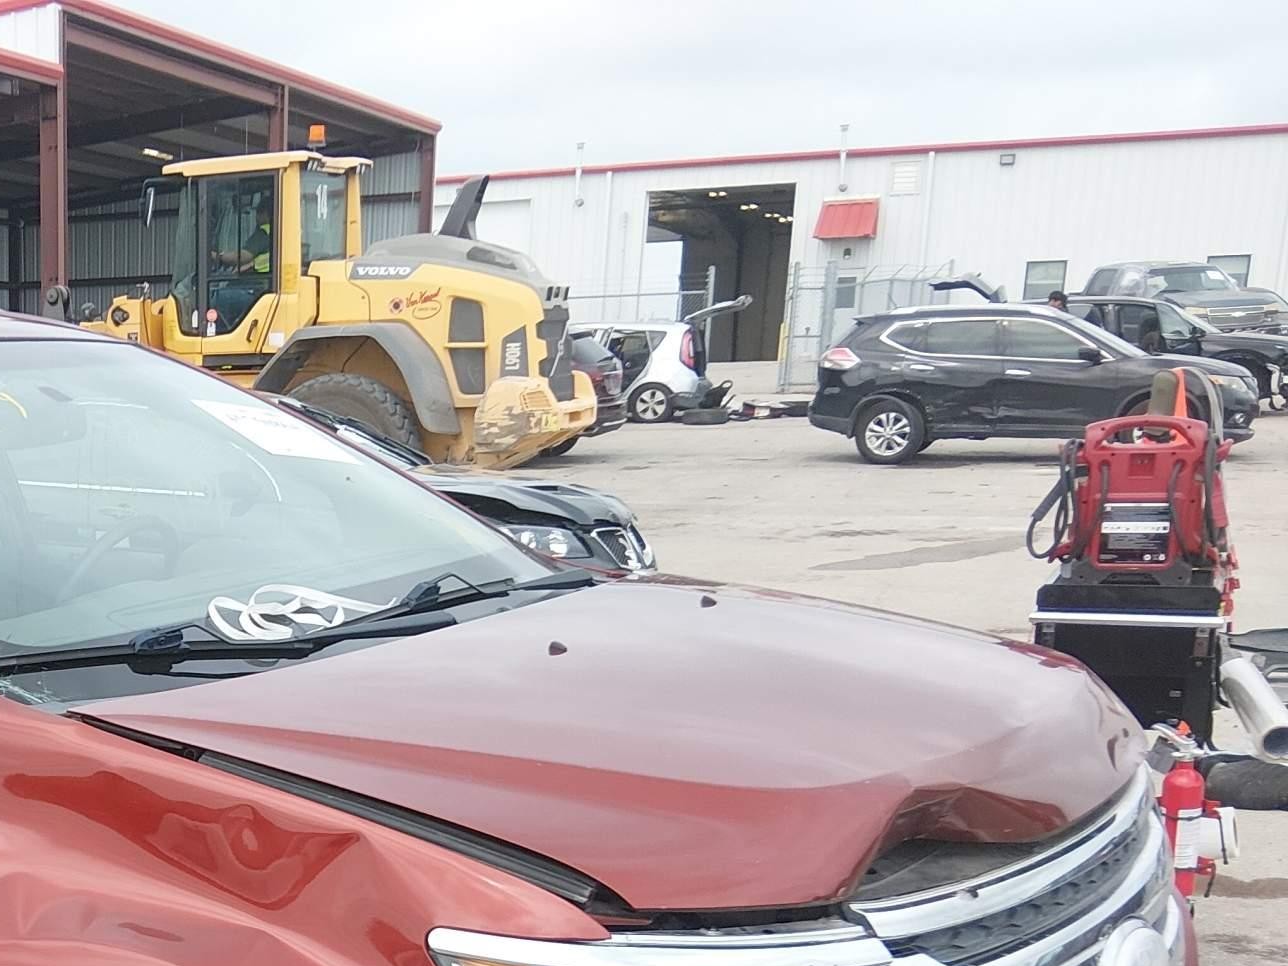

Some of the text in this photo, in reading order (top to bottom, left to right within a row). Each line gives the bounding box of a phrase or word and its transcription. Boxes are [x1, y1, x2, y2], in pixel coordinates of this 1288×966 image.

[315, 183, 328, 220] 14
[356, 266, 411, 276] VOLVO
[504, 342, 522, 371] L90H
